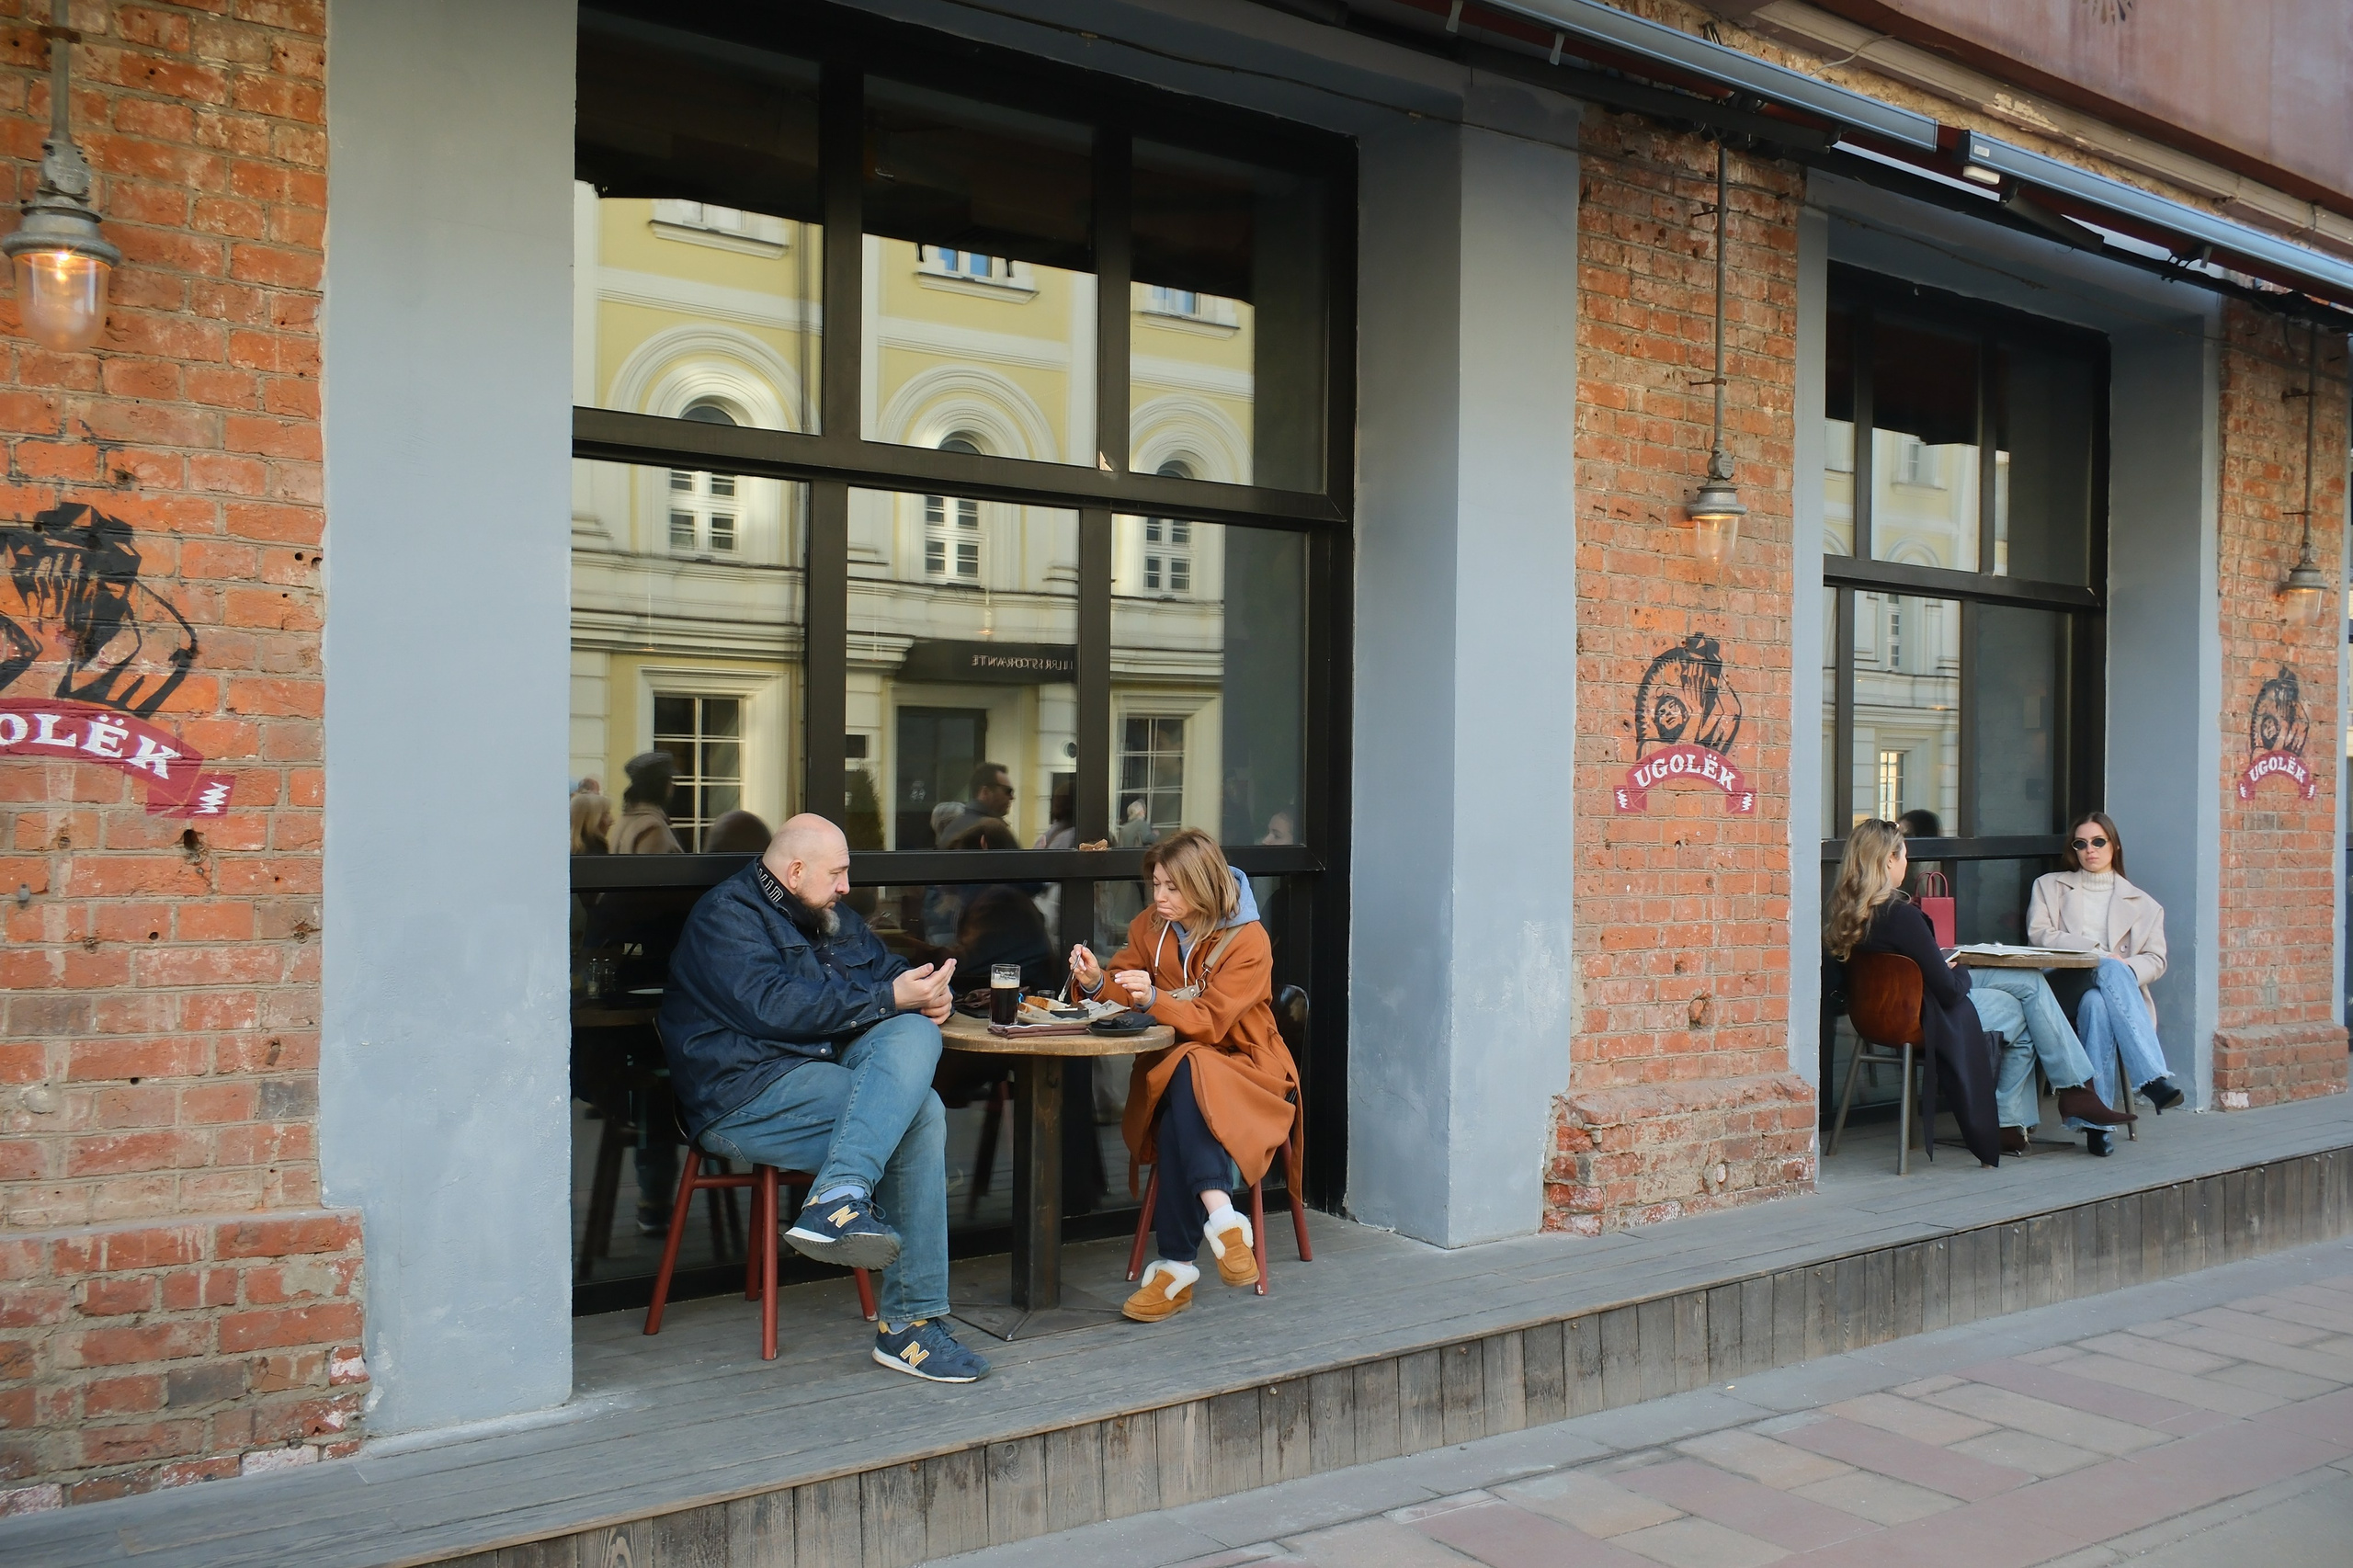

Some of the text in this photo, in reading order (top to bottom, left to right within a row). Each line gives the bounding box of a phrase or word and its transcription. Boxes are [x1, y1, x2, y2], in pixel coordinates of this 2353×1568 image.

[1633, 754, 1736, 791] UGOLËK
[2247, 756, 2306, 784] UGOLËK
[827, 1204, 859, 1229] N
[900, 1340, 930, 1368] N
